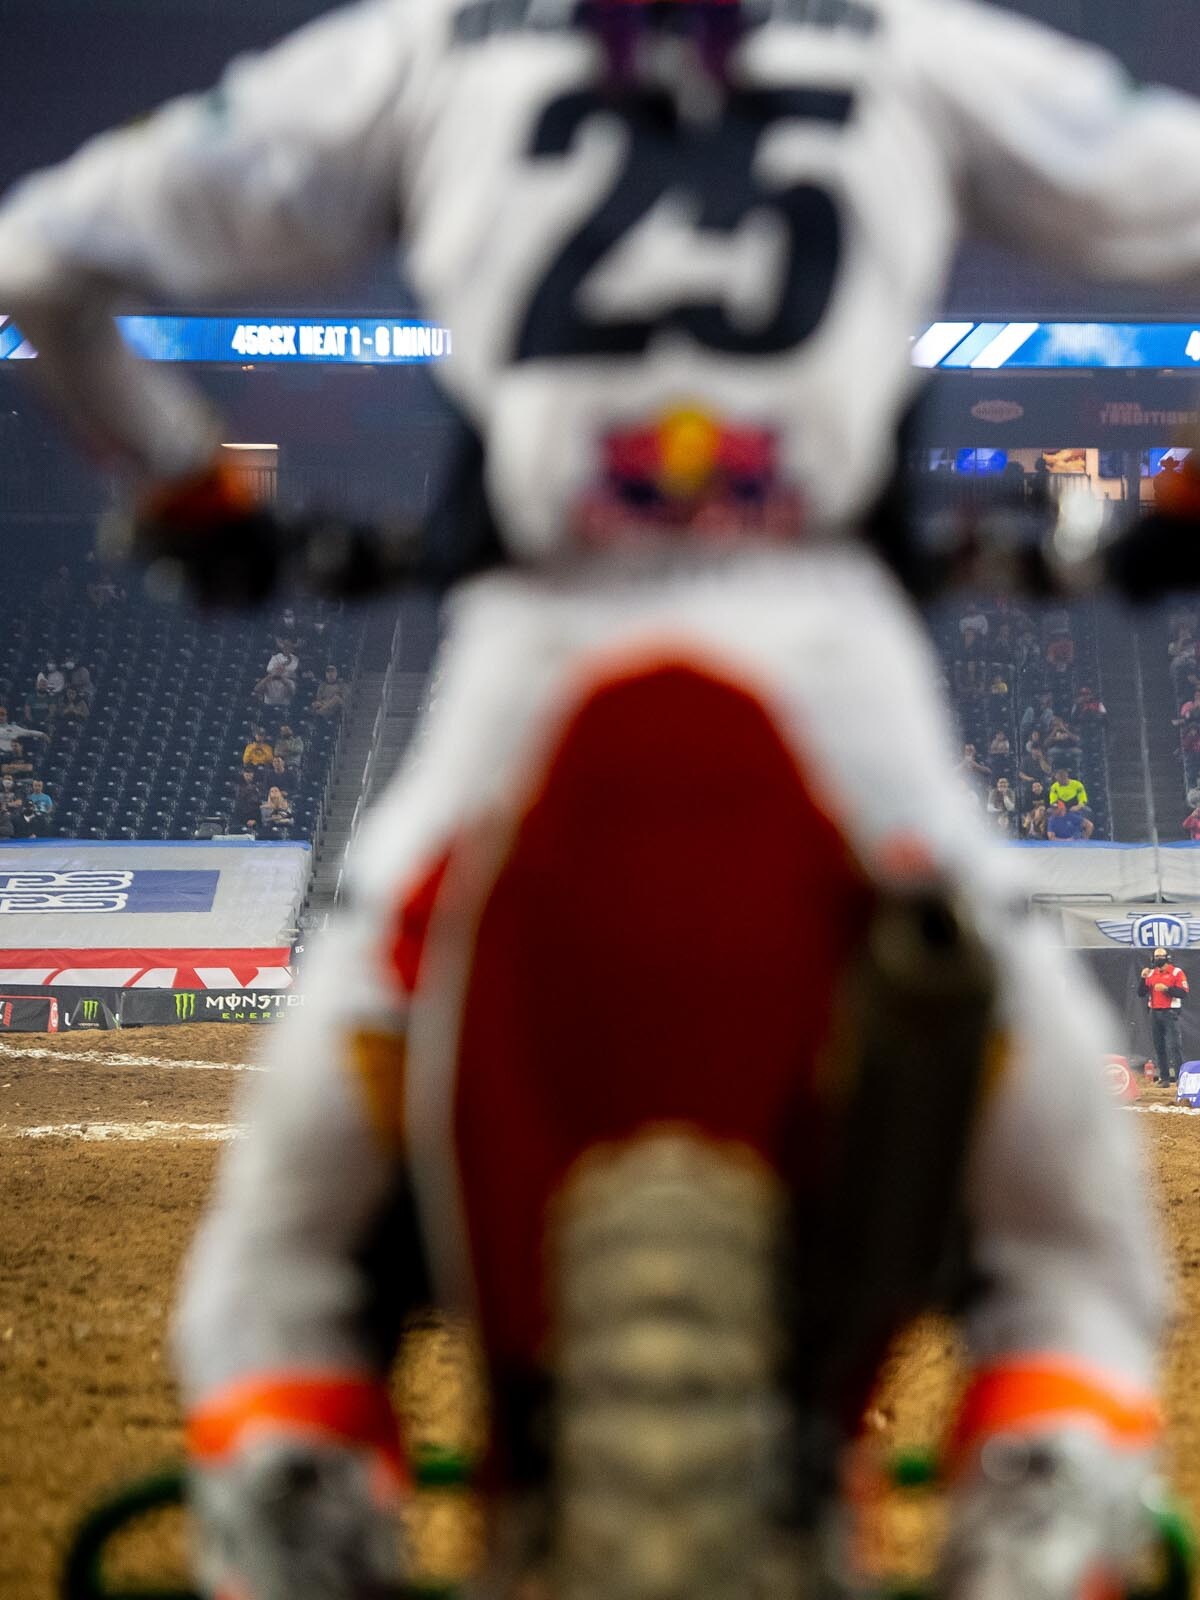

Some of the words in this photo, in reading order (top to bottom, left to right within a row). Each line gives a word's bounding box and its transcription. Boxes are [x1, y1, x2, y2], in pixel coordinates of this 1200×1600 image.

[512, 88, 862, 363] 25
[231, 325, 297, 355] 450SX
[300, 326, 350, 355] HEAT
[350, 326, 360, 355] 1
[392, 326, 453, 355] MINUT
[1140, 921, 1180, 946] FIM
[221, 1011, 286, 1020] ENERG
